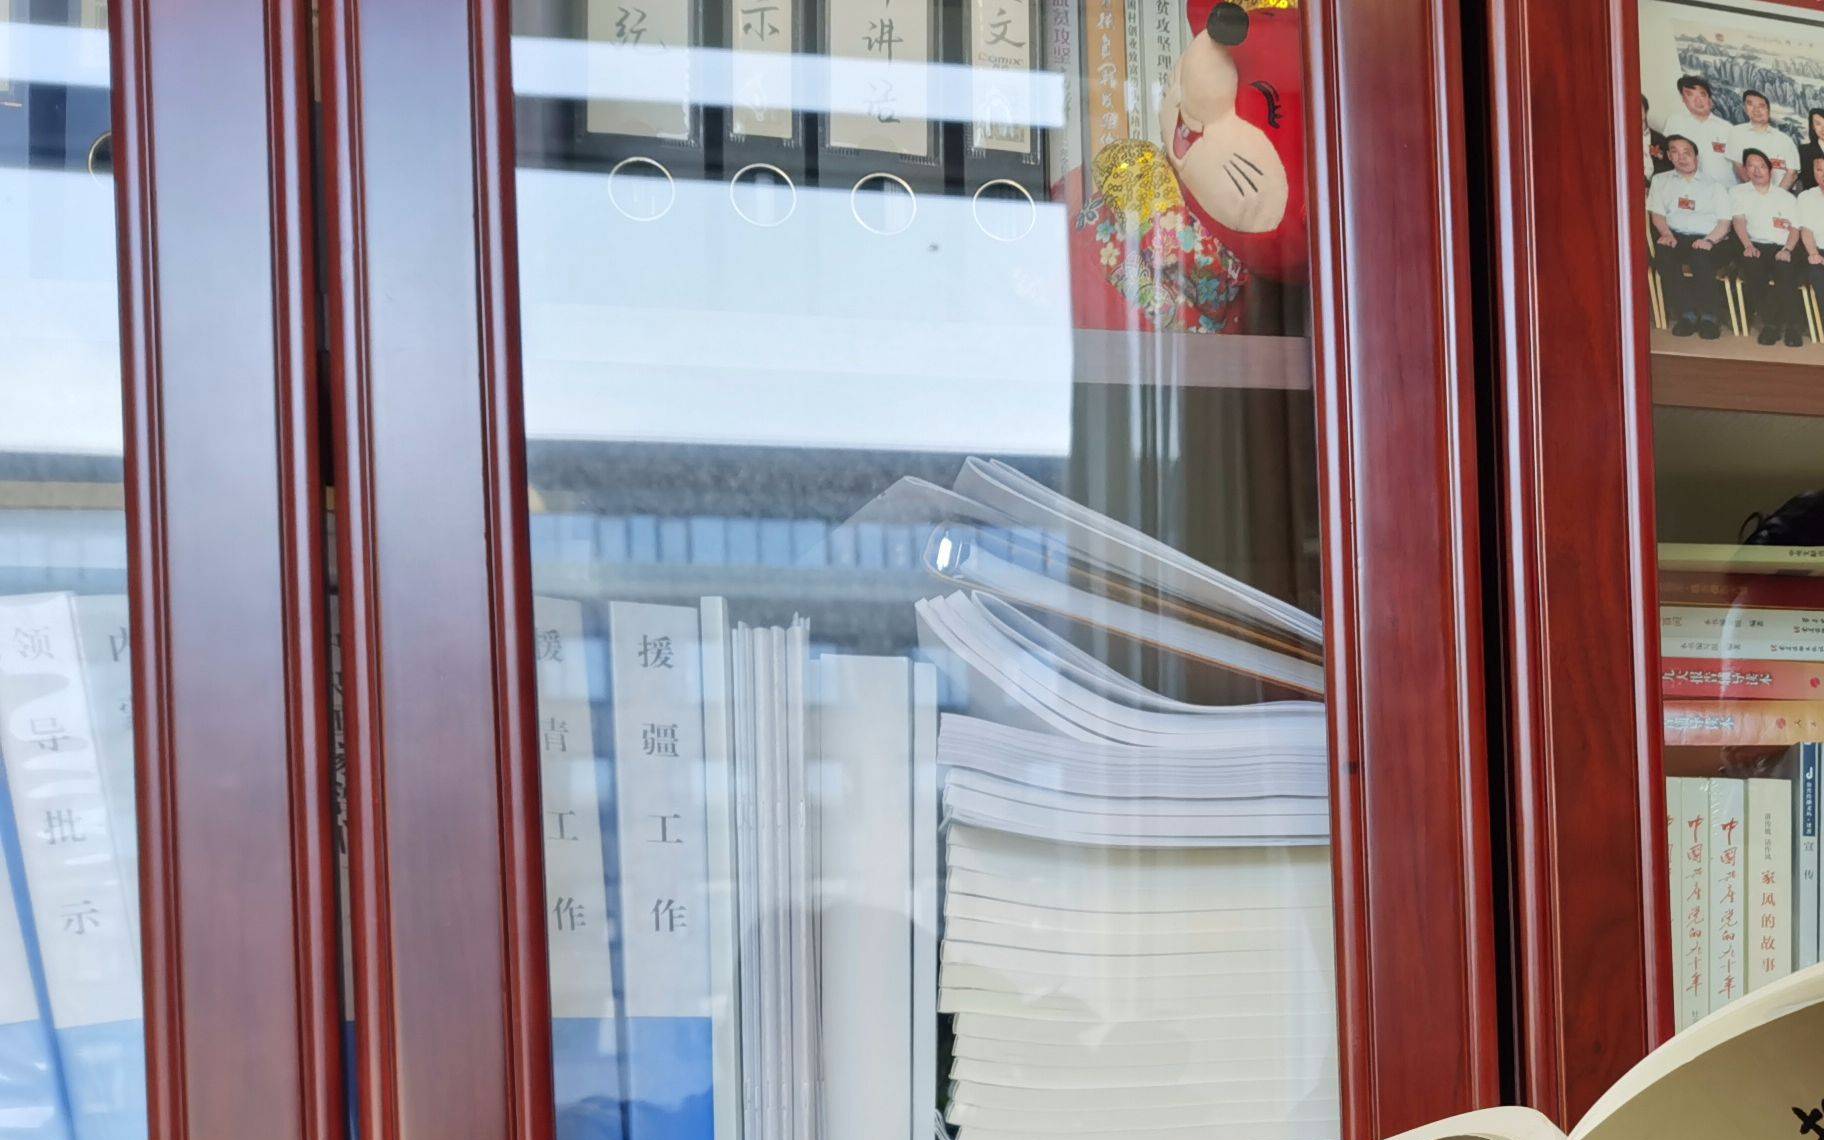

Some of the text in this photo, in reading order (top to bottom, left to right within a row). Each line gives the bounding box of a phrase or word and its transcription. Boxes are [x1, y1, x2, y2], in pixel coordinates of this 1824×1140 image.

[637, 633, 689, 934] 援疆工作
[1761, 870, 1776, 972] 家风的故事
